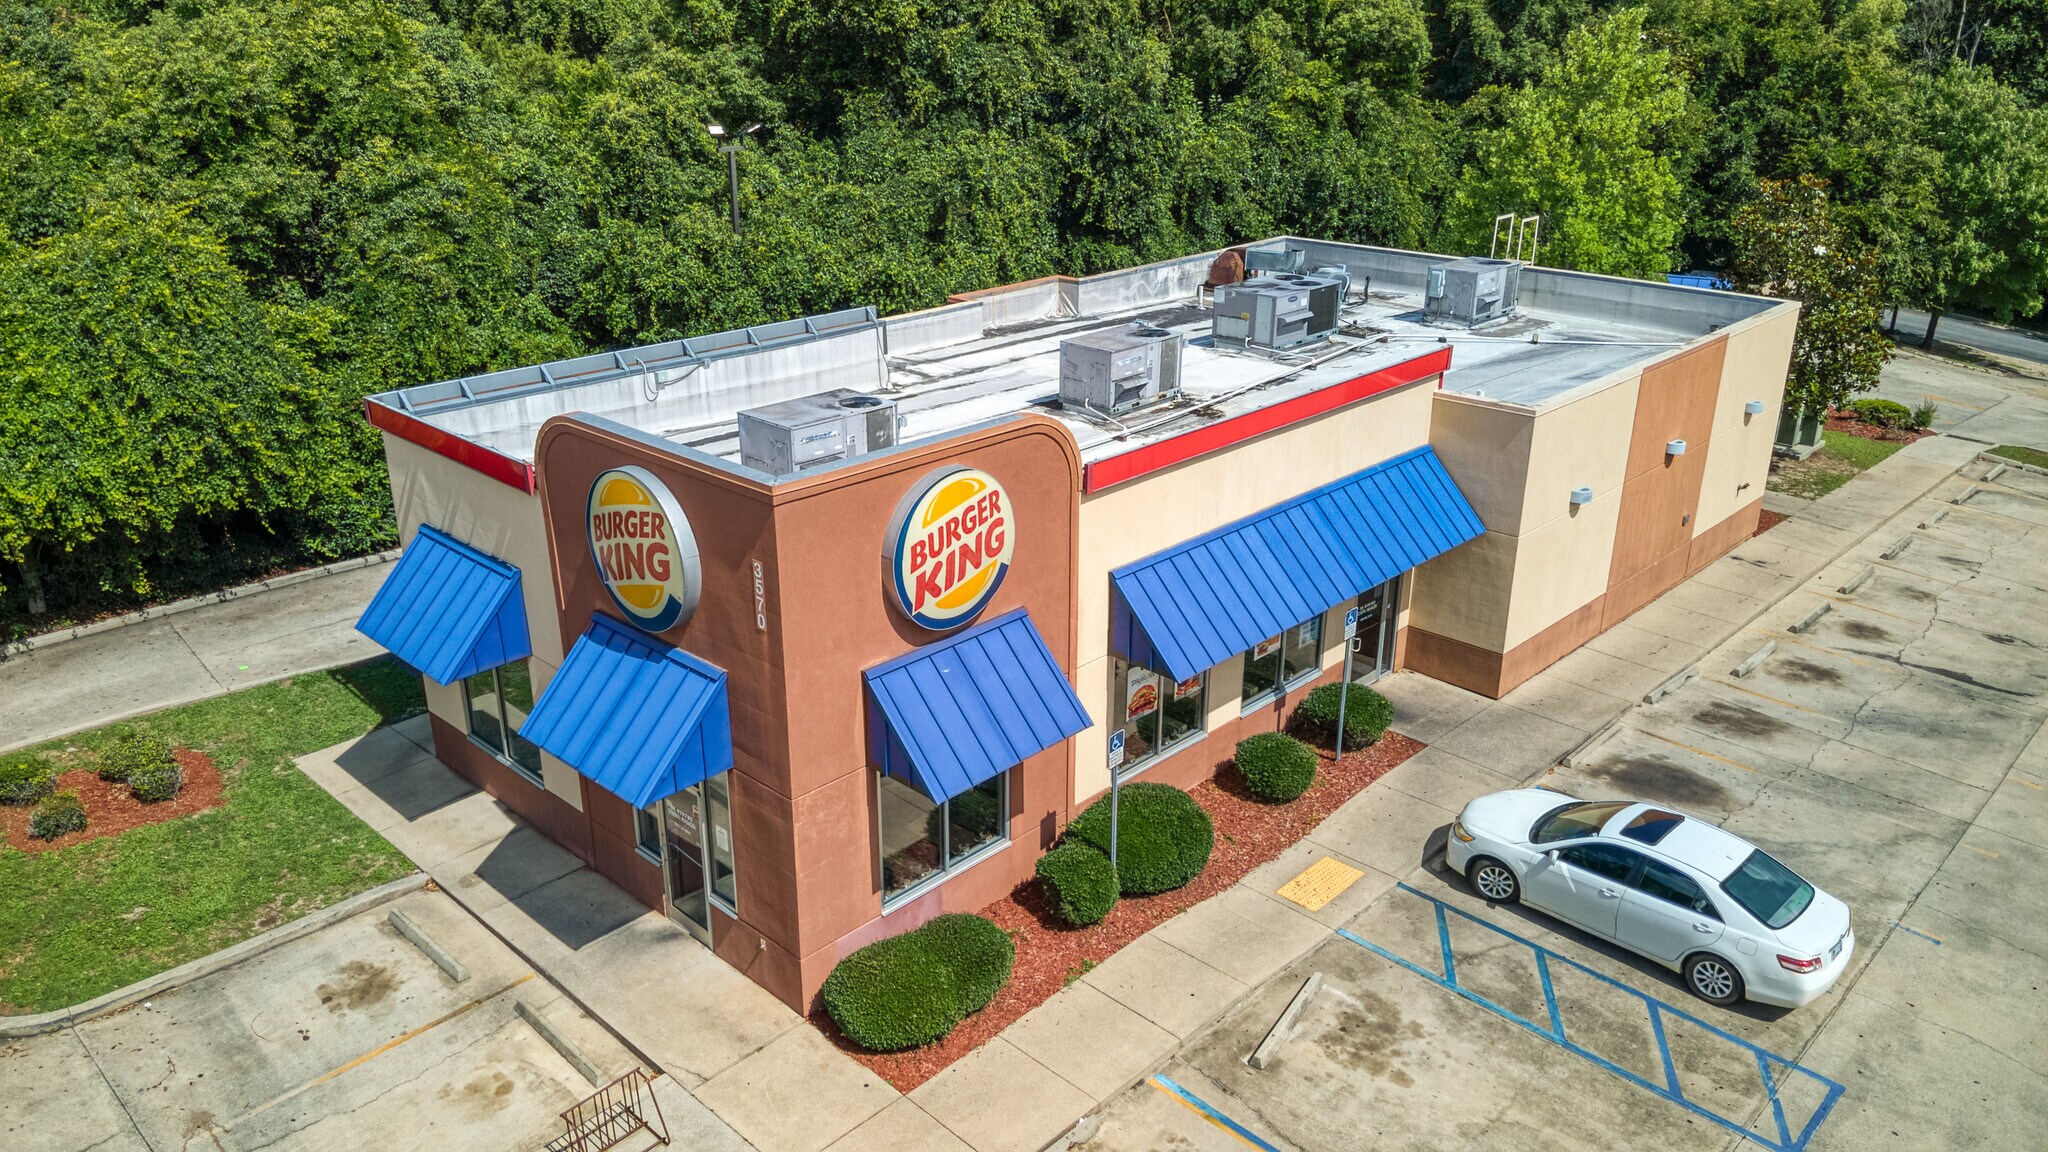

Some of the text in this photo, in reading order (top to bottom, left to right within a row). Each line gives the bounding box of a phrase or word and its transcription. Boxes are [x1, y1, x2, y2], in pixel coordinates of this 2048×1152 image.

[593, 510, 666, 542] BURGER
[910, 490, 1002, 574] BURGER
[599, 542, 671, 582] KING
[753, 562, 766, 629] 3570
[914, 517, 1005, 612] KING
